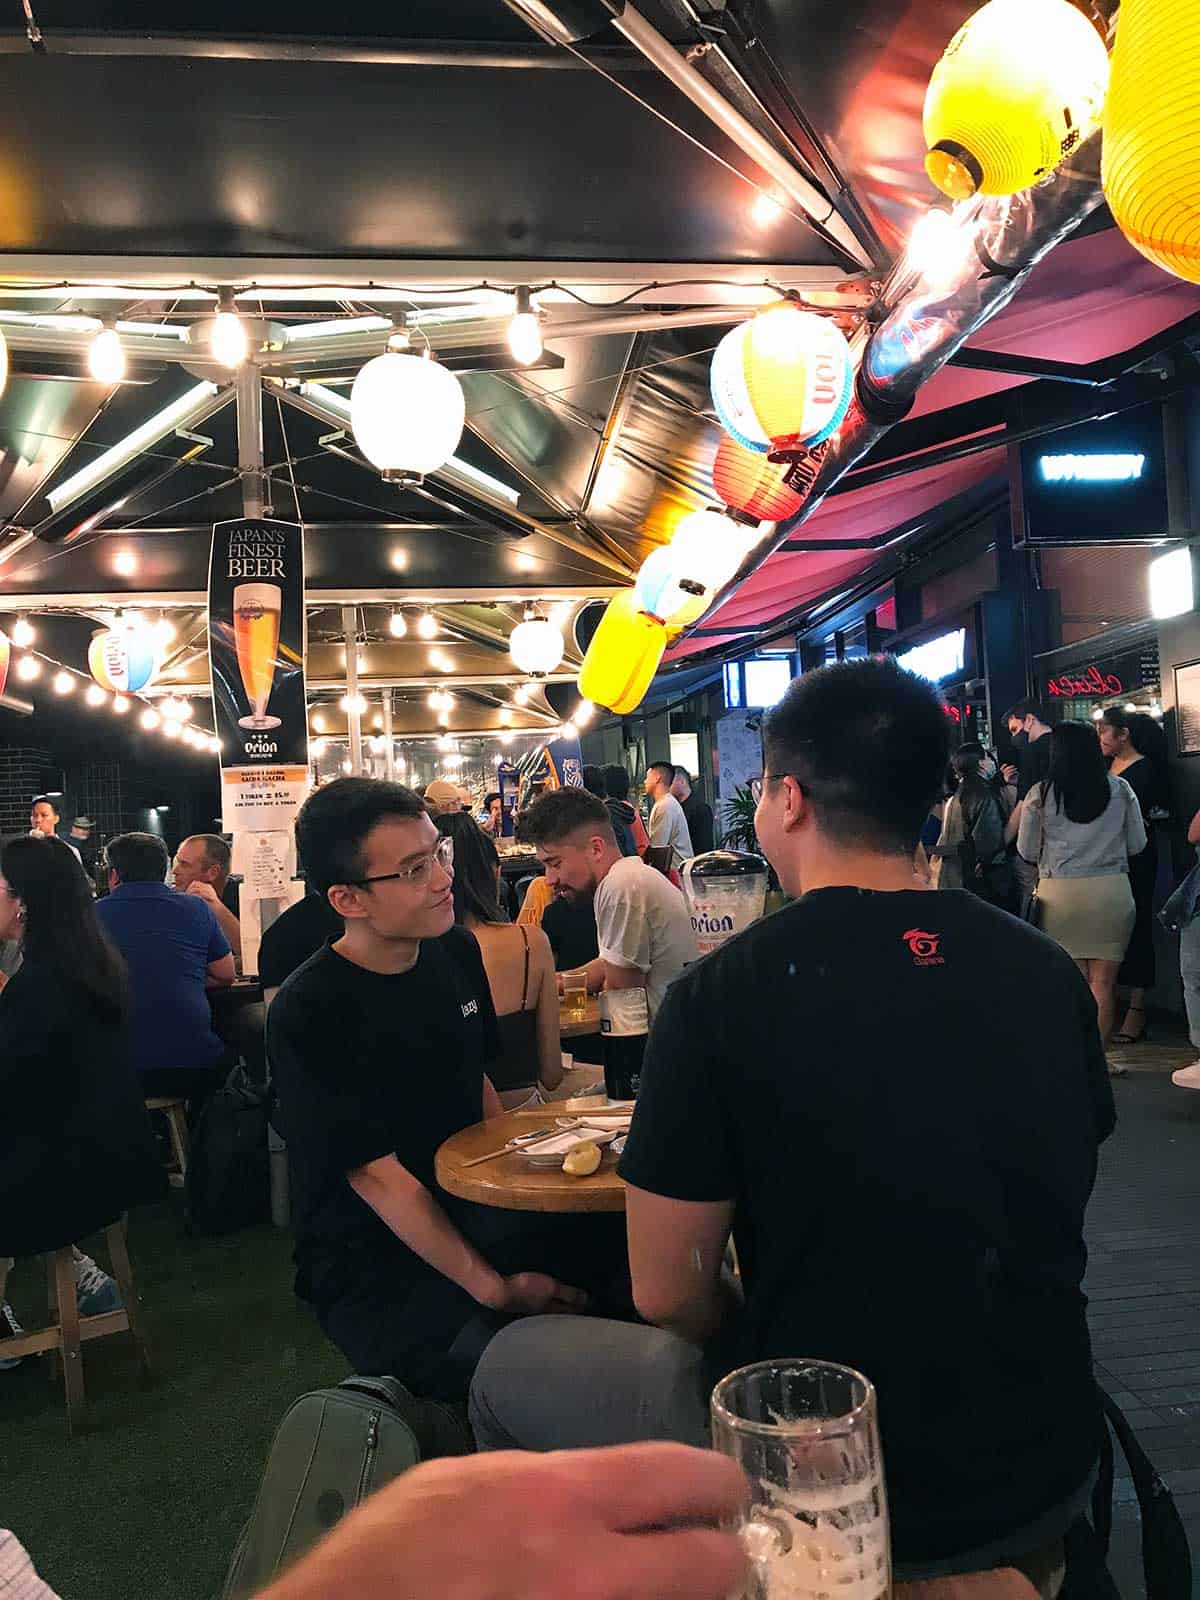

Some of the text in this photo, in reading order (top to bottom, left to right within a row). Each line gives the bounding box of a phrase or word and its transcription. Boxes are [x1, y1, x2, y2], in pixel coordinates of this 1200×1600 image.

[229, 528, 286, 544] JAPAN'S
[228, 543, 287, 559] FINEST
[226, 558, 287, 578] BEER
